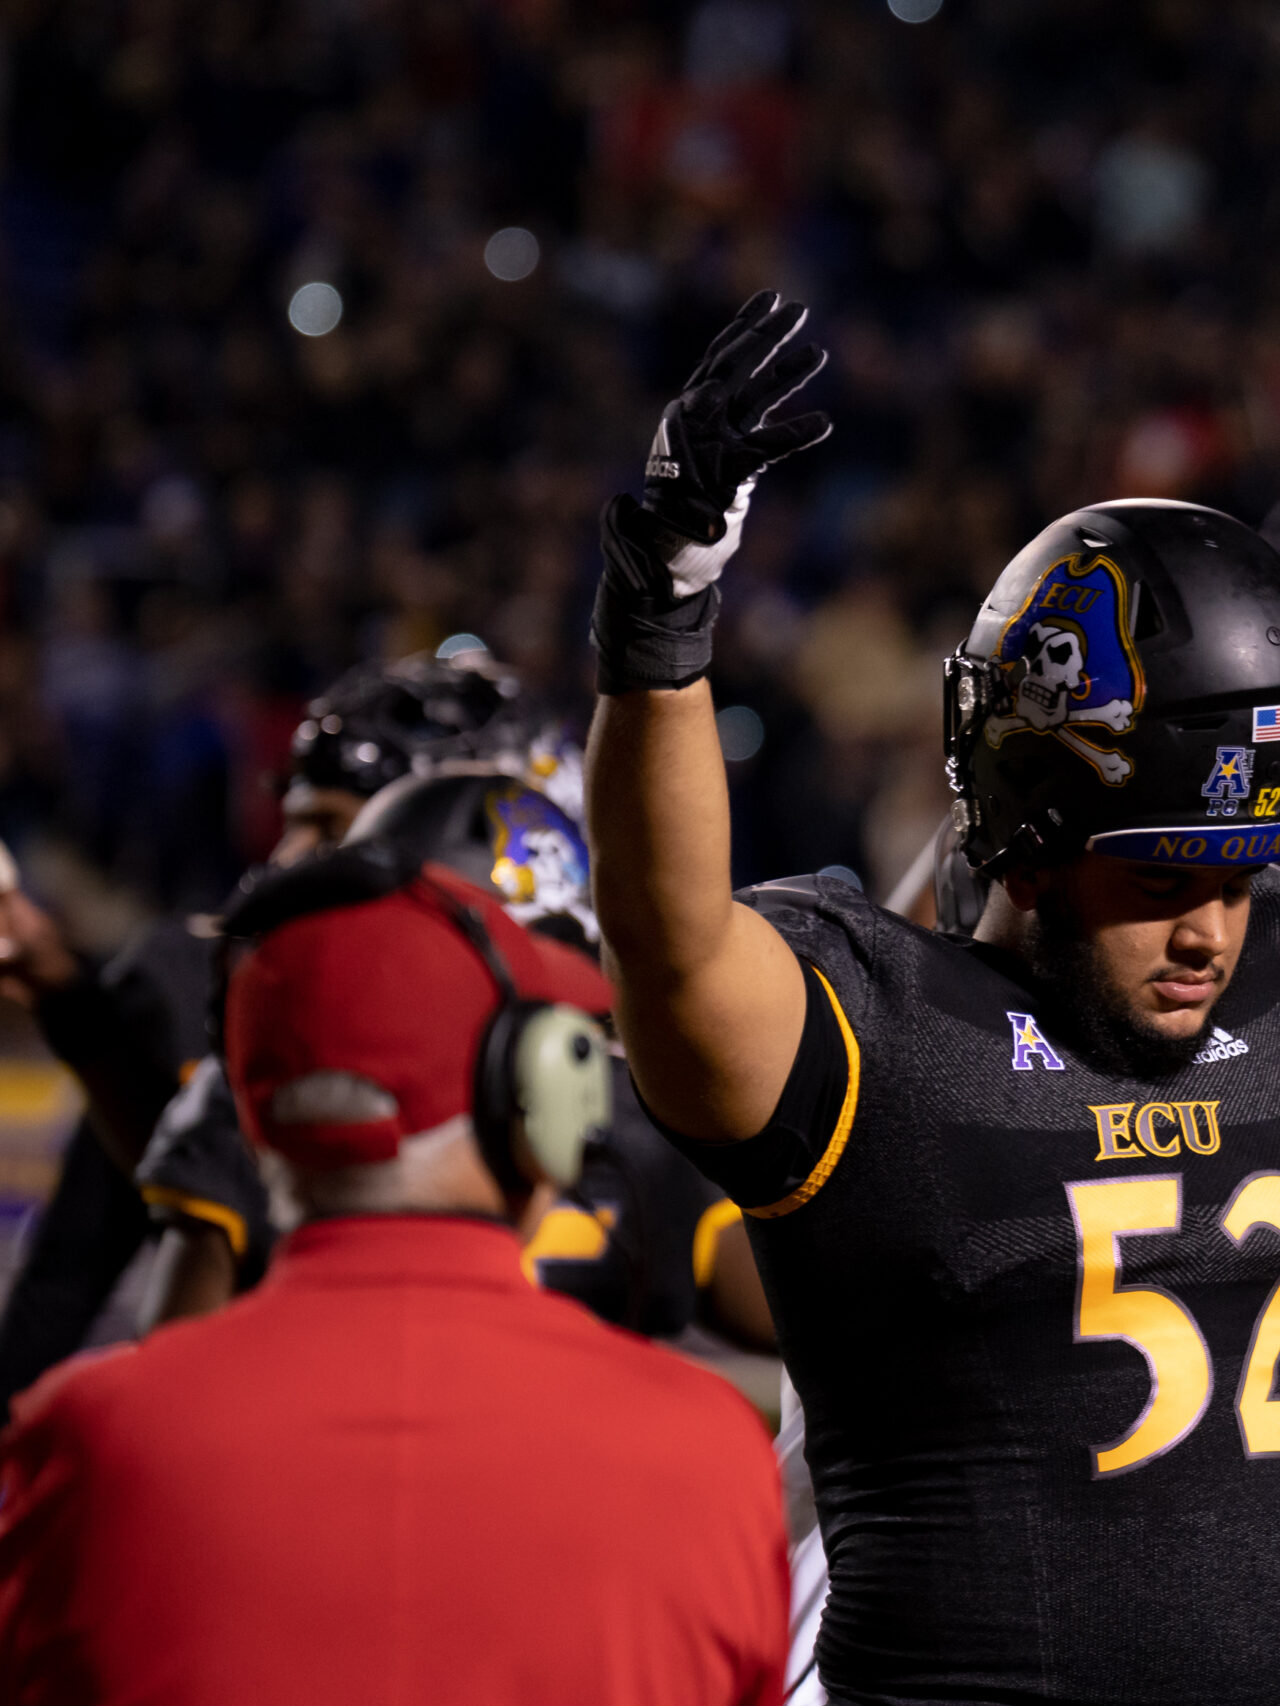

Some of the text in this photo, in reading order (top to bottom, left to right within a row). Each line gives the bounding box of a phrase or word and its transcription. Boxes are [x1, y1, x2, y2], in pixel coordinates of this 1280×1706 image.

[1039, 582, 1104, 614] ECU
[1152, 836, 1207, 859] NO
[1087, 1100, 1221, 1161] ECU
